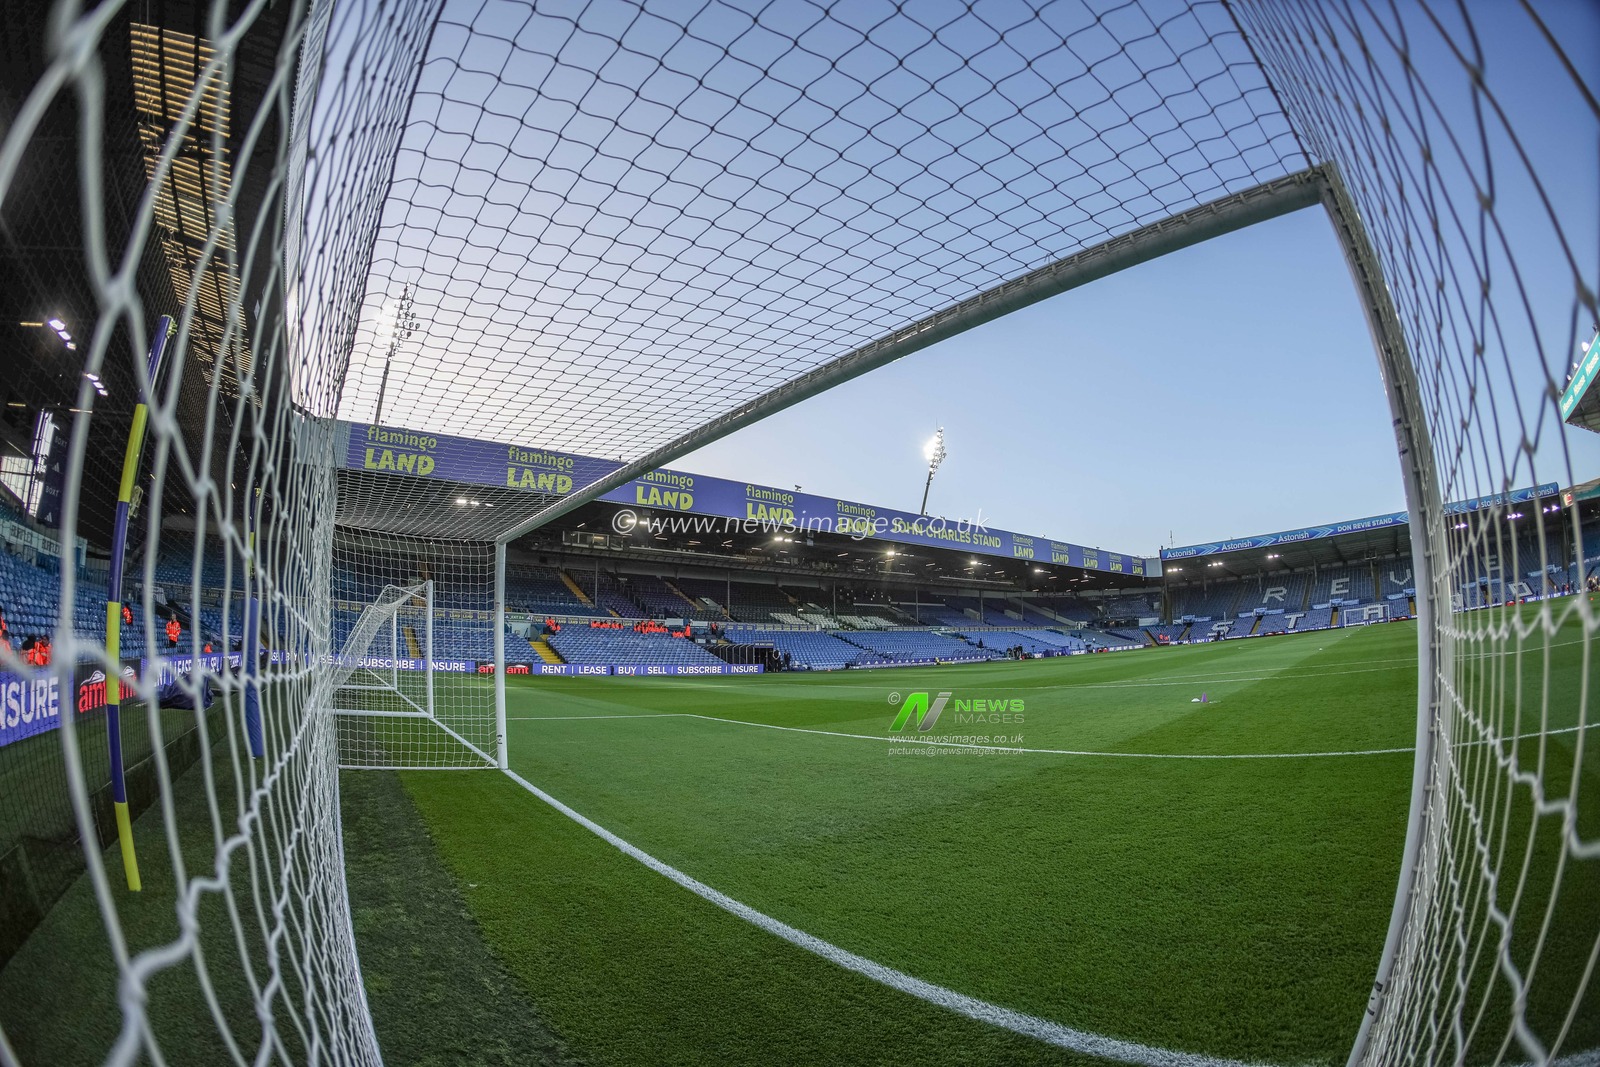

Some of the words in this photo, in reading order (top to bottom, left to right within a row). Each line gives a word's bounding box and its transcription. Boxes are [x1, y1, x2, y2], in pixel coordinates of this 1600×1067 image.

[367, 425, 437, 451] flamingo
[364, 448, 435, 476] LAND
[508, 446, 574, 472] flamingo
[507, 468, 573, 494] LAND
[643, 470, 694, 490] lamingo
[636, 486, 694, 511] LAND
[746, 485, 794, 505] flamingo
[1526, 487, 1555, 499] Asonish
[746, 502, 795, 525] LAND
[837, 501, 876, 518] flamingo
[837, 517, 876, 537] LAND
[893, 519, 923, 537] JOHN
[926, 525, 971, 544] CHARLES
[973, 533, 1001, 548] STAND
[1166, 549, 1197, 559] Astonish
[1221, 539, 1253, 551] Astonish
[1277, 531, 1310, 543] Astonish
[1353, 521, 1371, 530] REVIE
[1372, 517, 1393, 526] STAND
[1013, 545, 1035, 559] LAND
[1051, 552, 1069, 565] LAND
[431, 661, 466, 672] NSURE
[506, 665, 529, 674] amt
[541, 665, 567, 674] RENT
[578, 665, 607, 674] LEASE
[618, 666, 637, 674] BUY
[647, 666, 667, 674] SELL
[677, 666, 722, 674] SUBSCRIBE
[731, 665, 758, 673] INSURE
